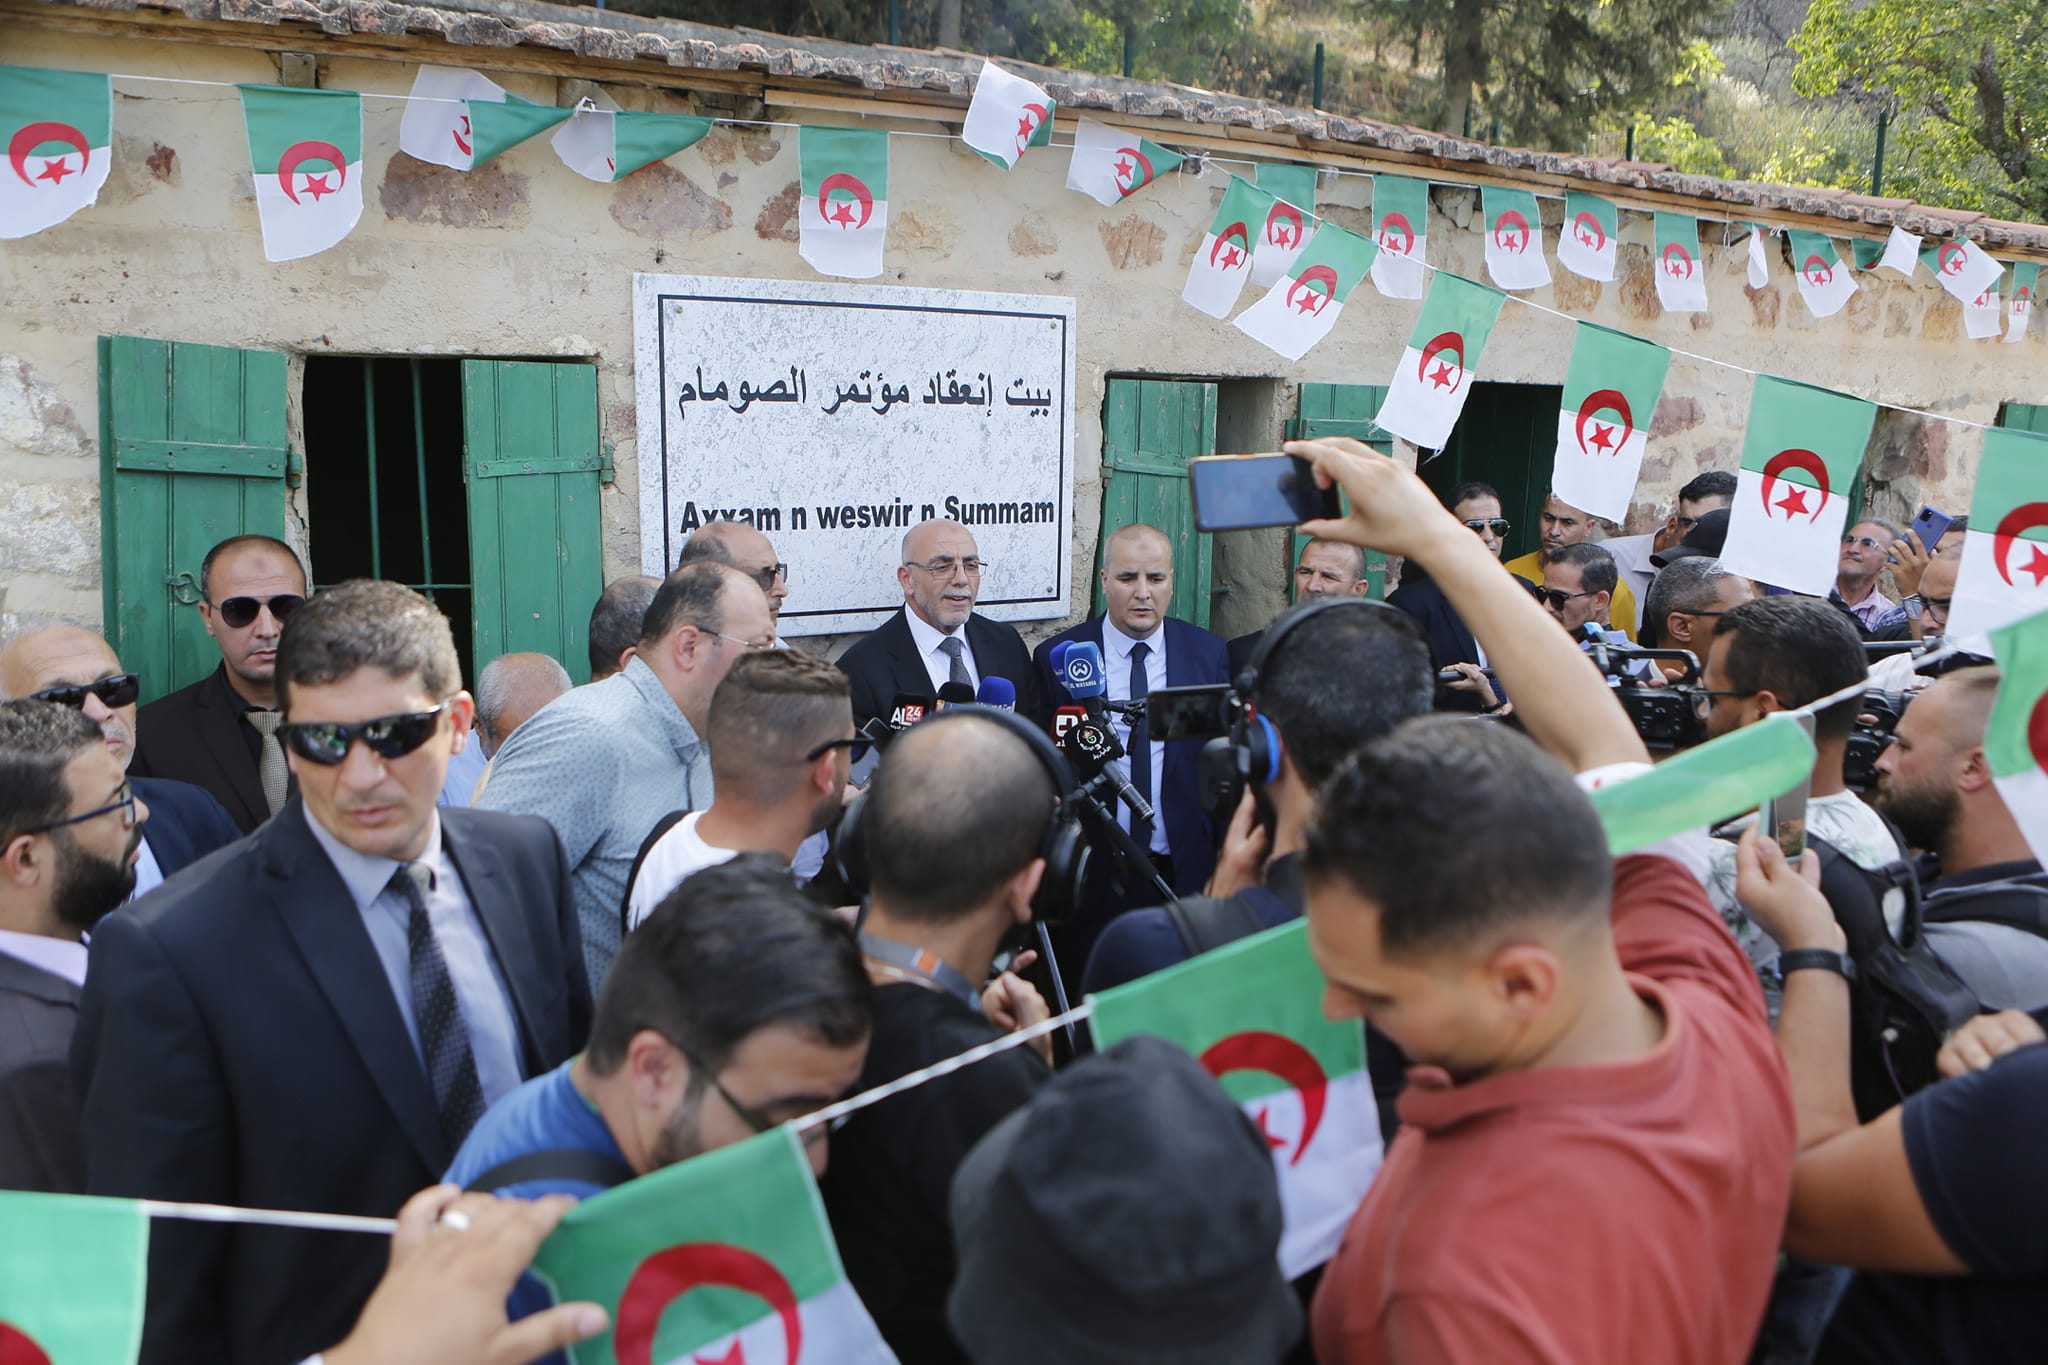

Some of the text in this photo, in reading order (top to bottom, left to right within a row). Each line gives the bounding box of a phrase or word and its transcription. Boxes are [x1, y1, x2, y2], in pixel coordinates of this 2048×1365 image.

[679, 365, 1051, 420] بيت إنعقاد مؤتمر الصومام
[791, 506, 807, 530] n
[816, 497, 913, 529] weswir
[921, 503, 936, 523] n
[944, 495, 1054, 526] Summam
